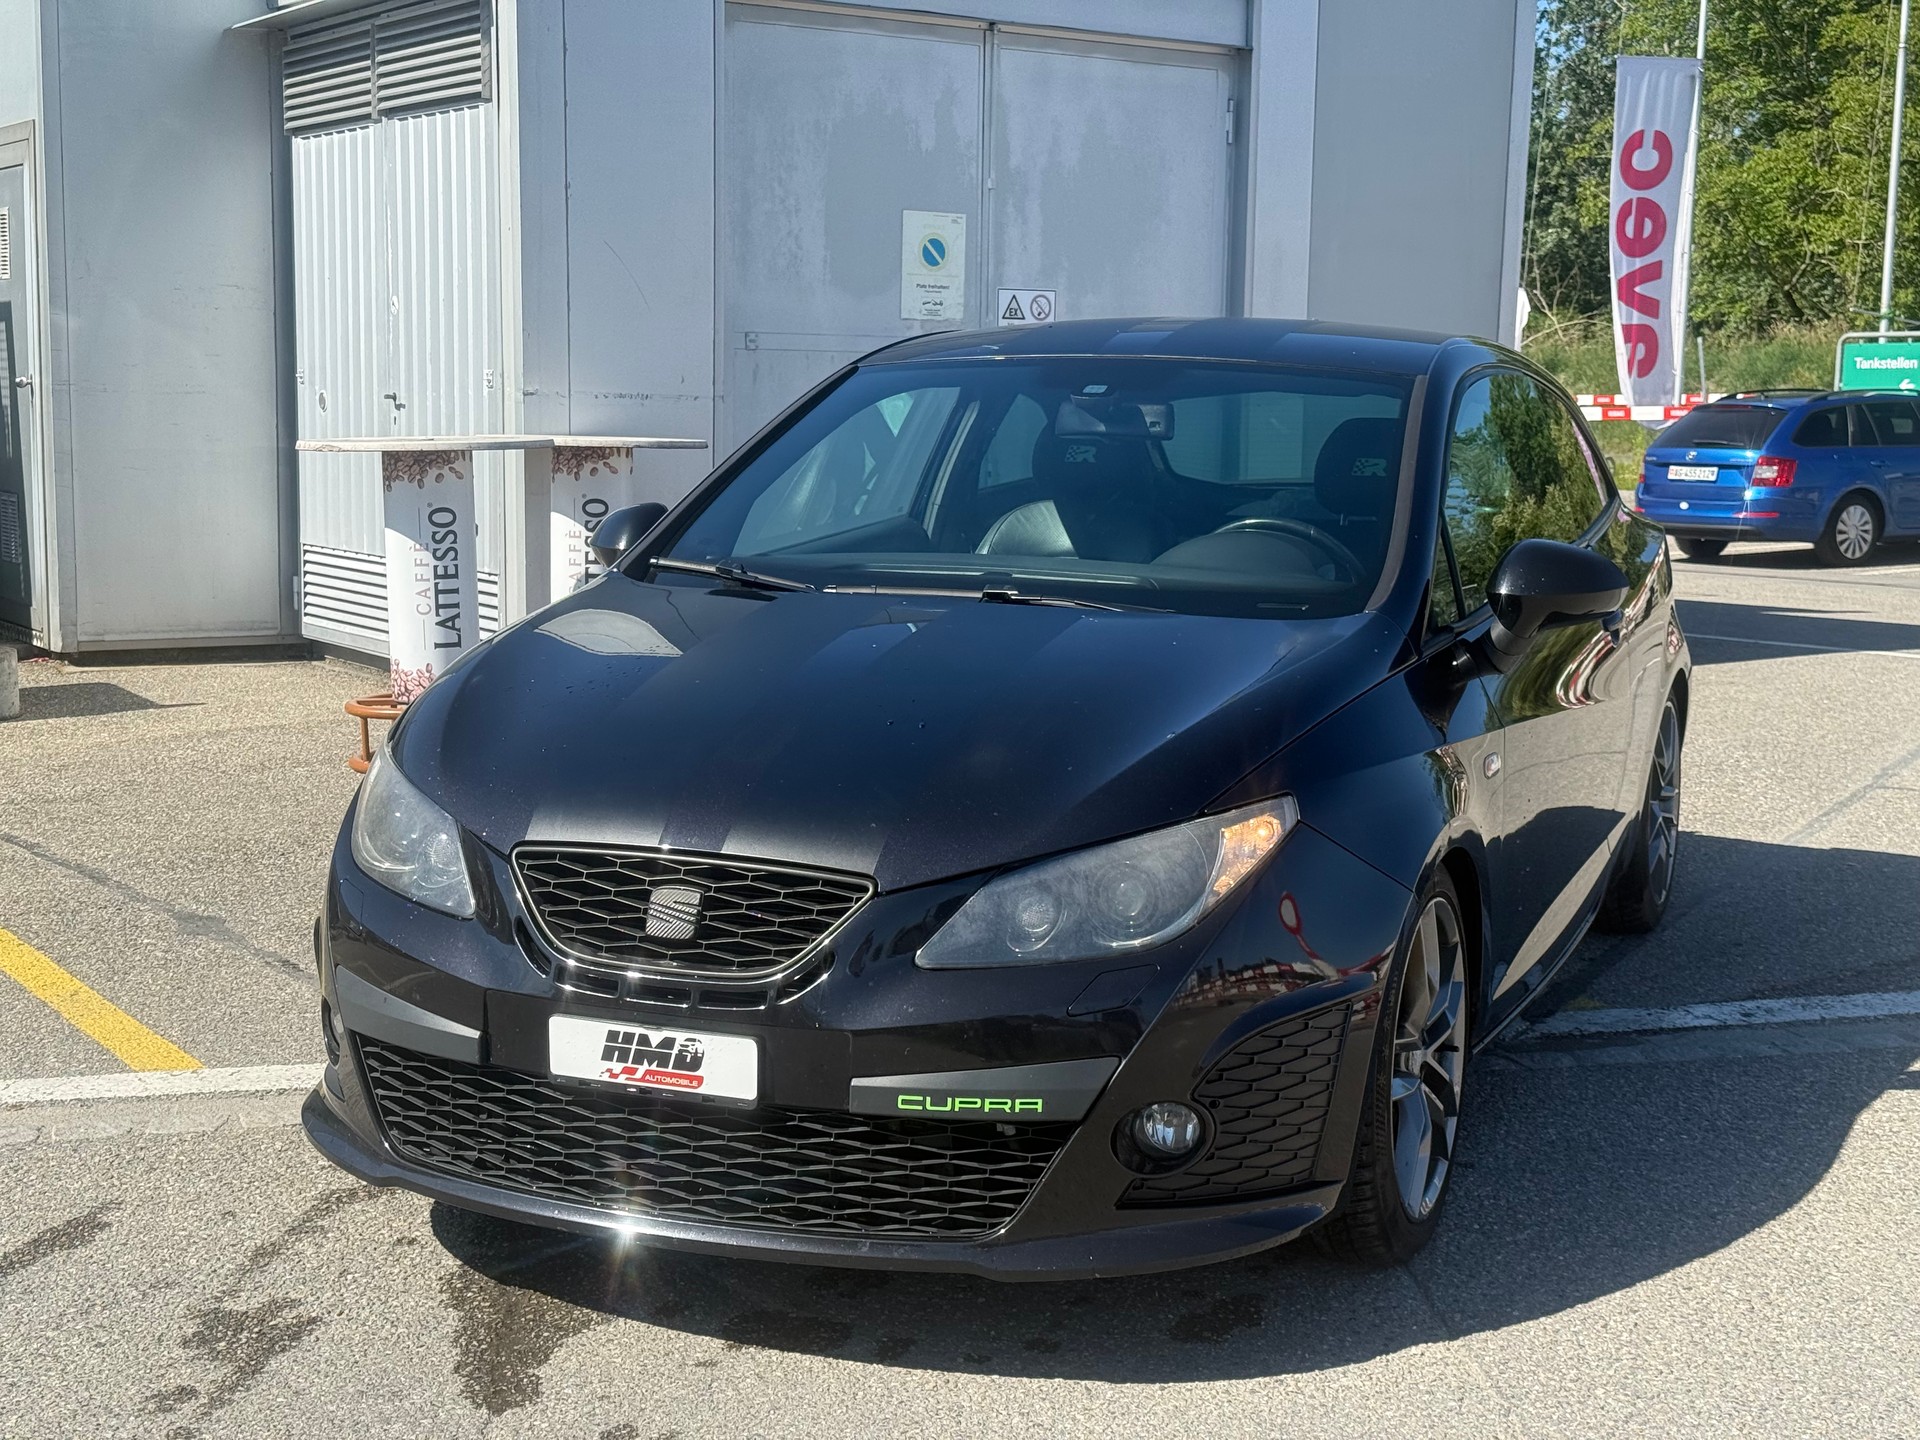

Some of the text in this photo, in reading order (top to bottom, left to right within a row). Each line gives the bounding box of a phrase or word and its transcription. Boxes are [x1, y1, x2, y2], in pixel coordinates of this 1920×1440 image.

[1009, 308, 1019, 317] EX
[1854, 356, 1918, 370] Tankstellen
[409, 542, 432, 616] CAFFÈ
[428, 506, 462, 650] LATTESSO
[645, 1074, 699, 1087] AUTOMOBILE
[897, 1094, 1043, 1113] CUPRA
